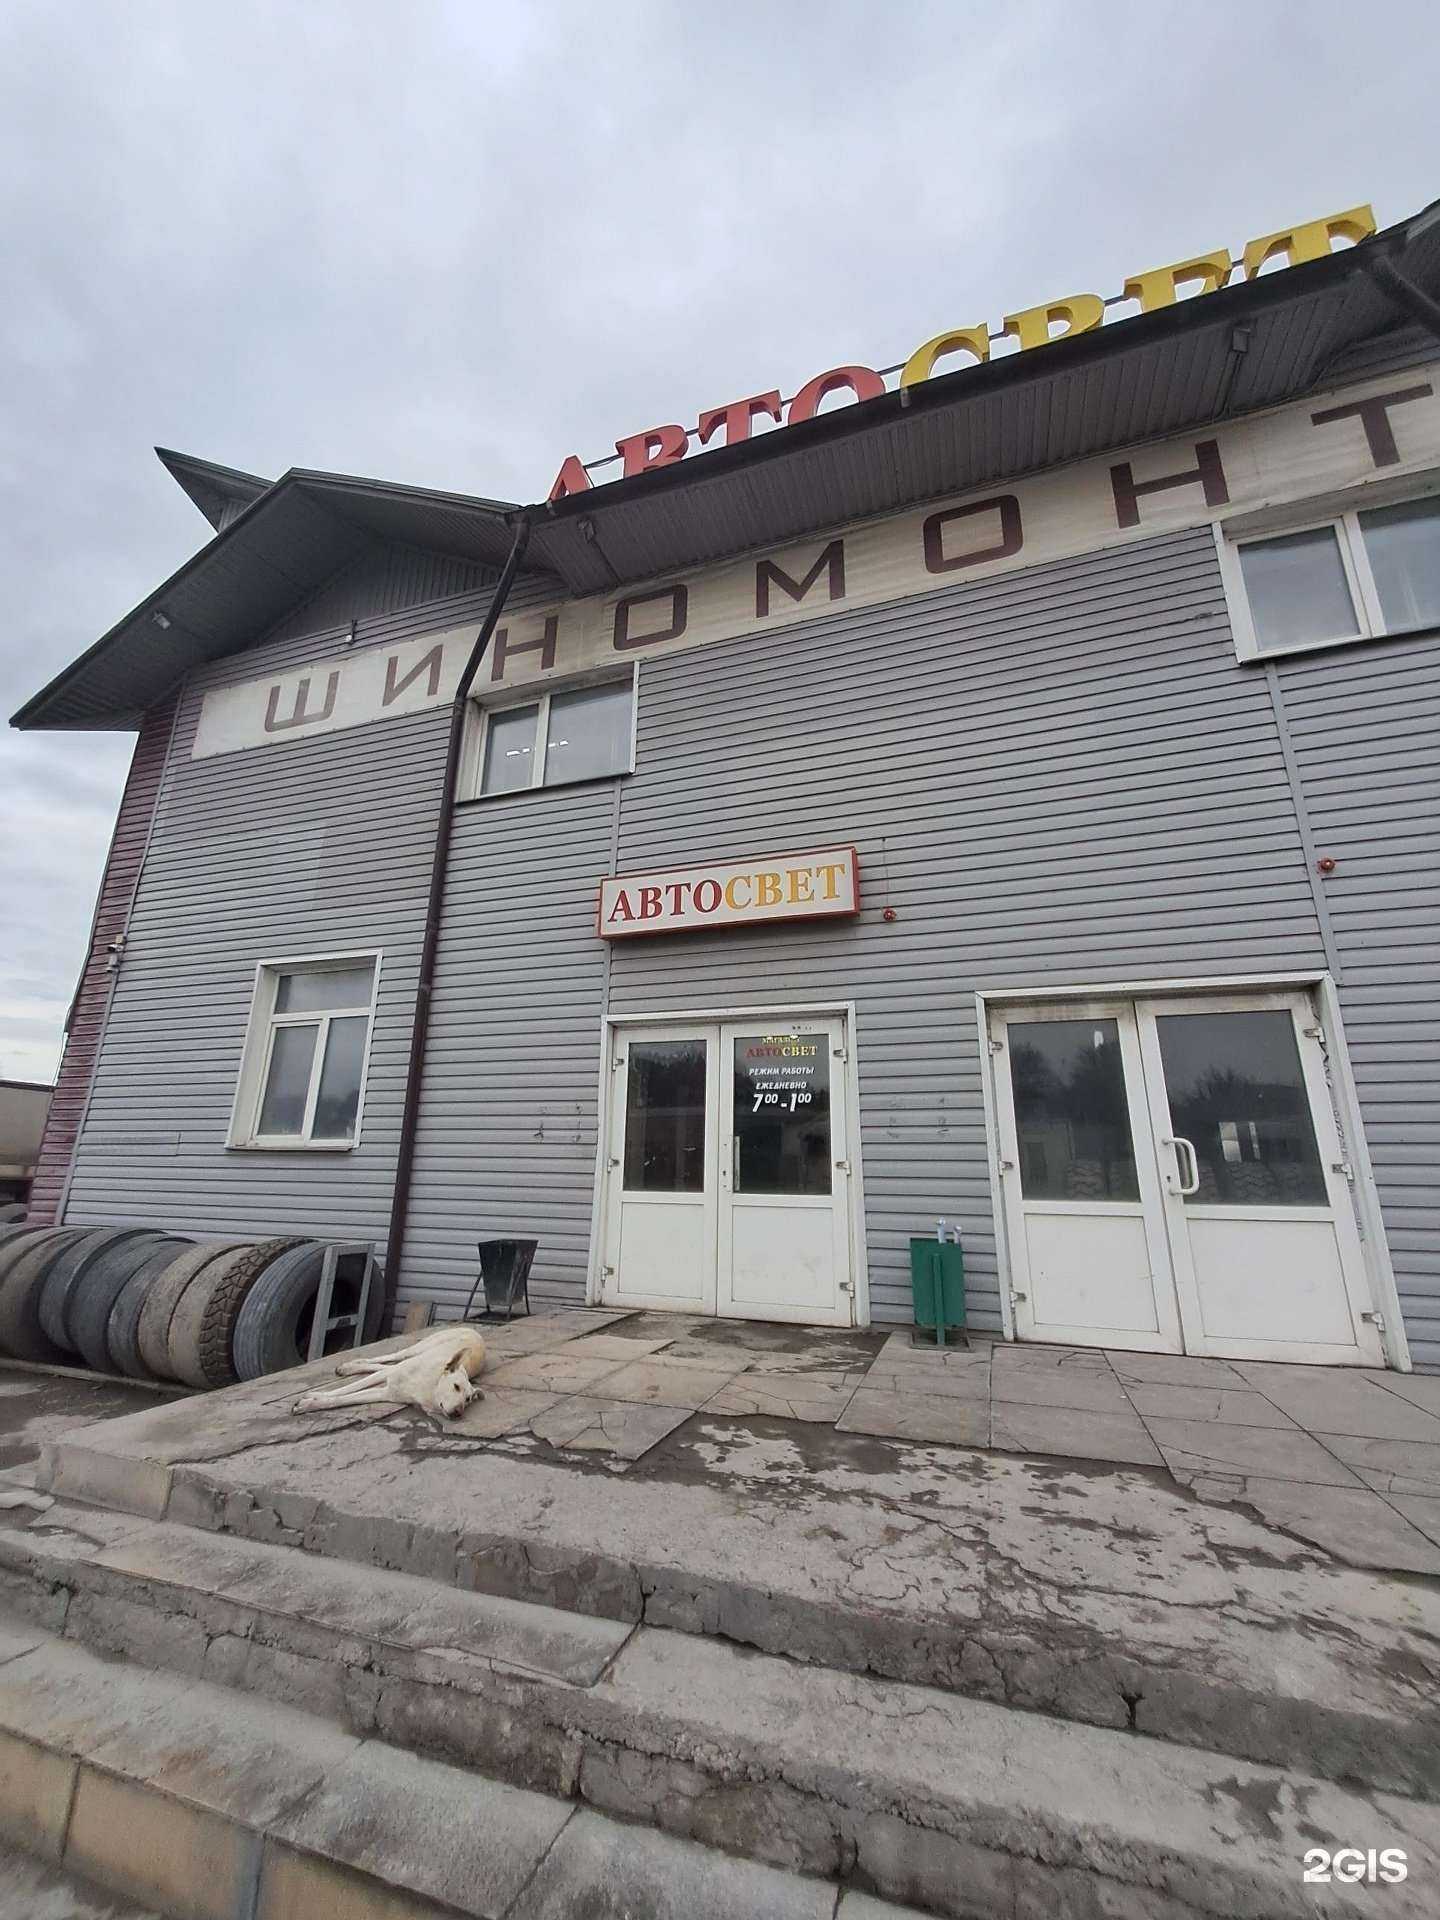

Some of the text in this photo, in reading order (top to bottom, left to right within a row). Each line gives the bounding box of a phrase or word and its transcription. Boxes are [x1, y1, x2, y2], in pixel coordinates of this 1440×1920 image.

[264, 384, 1434, 733] ШИНОМОНТ
[607, 864, 846, 923] АВТОСВЕТ
[745, 1045, 817, 1057] АВТОСВЕТ
[749, 1066, 815, 1076] РЕЖИМ РАБОТЫ
[755, 1081, 807, 1090] ЕЖЕДНЕВНО
